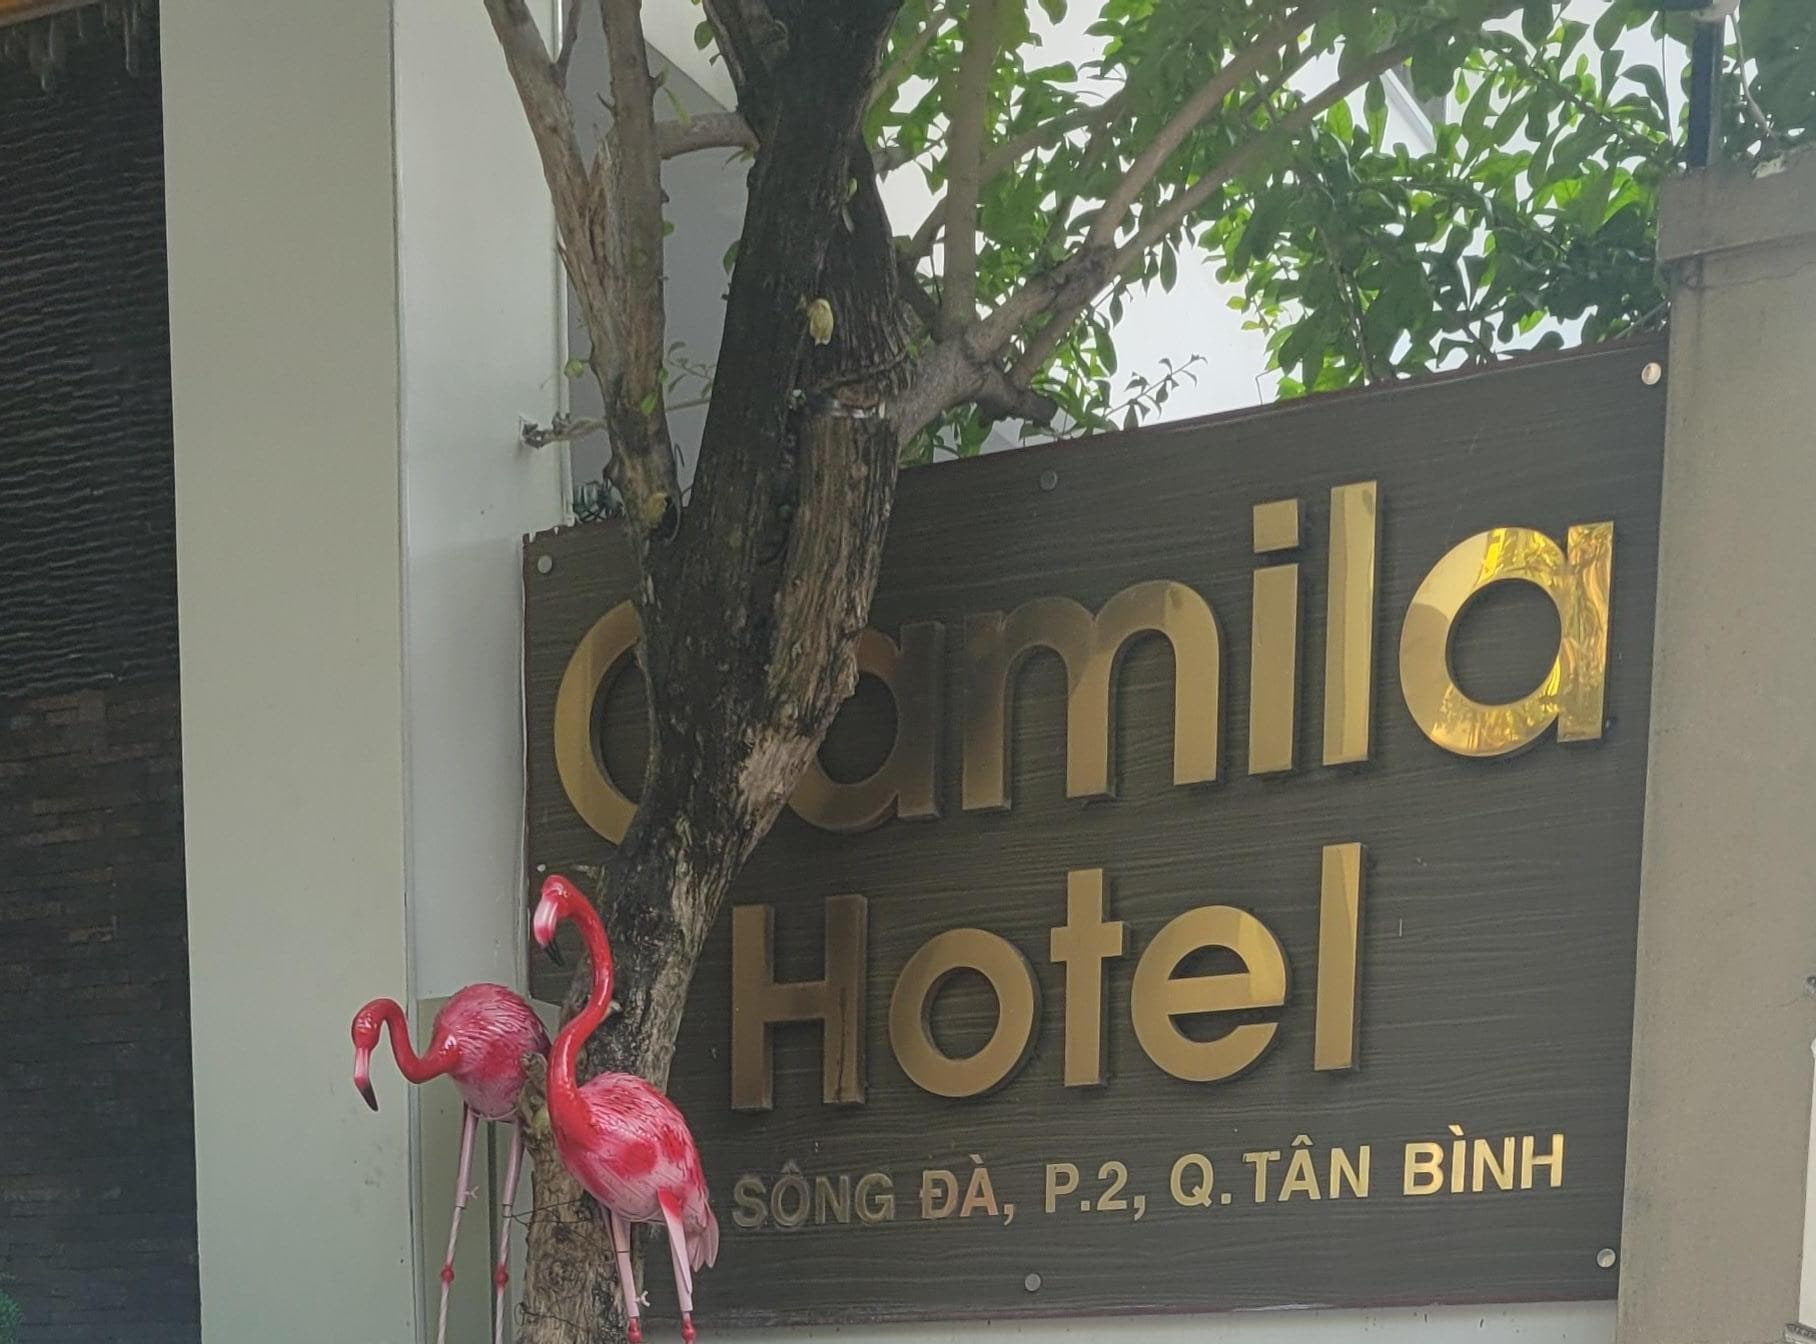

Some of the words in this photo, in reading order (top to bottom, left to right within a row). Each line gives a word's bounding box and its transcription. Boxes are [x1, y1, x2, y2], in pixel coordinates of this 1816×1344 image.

[730, 842, 1366, 1111] Hotel
[731, 1159, 896, 1229] SÔNG
[919, 1153, 1015, 1226] ĐÀ,
[1045, 1160, 1146, 1222] P.2,
[1402, 1124, 1565, 1196] BÌNH
